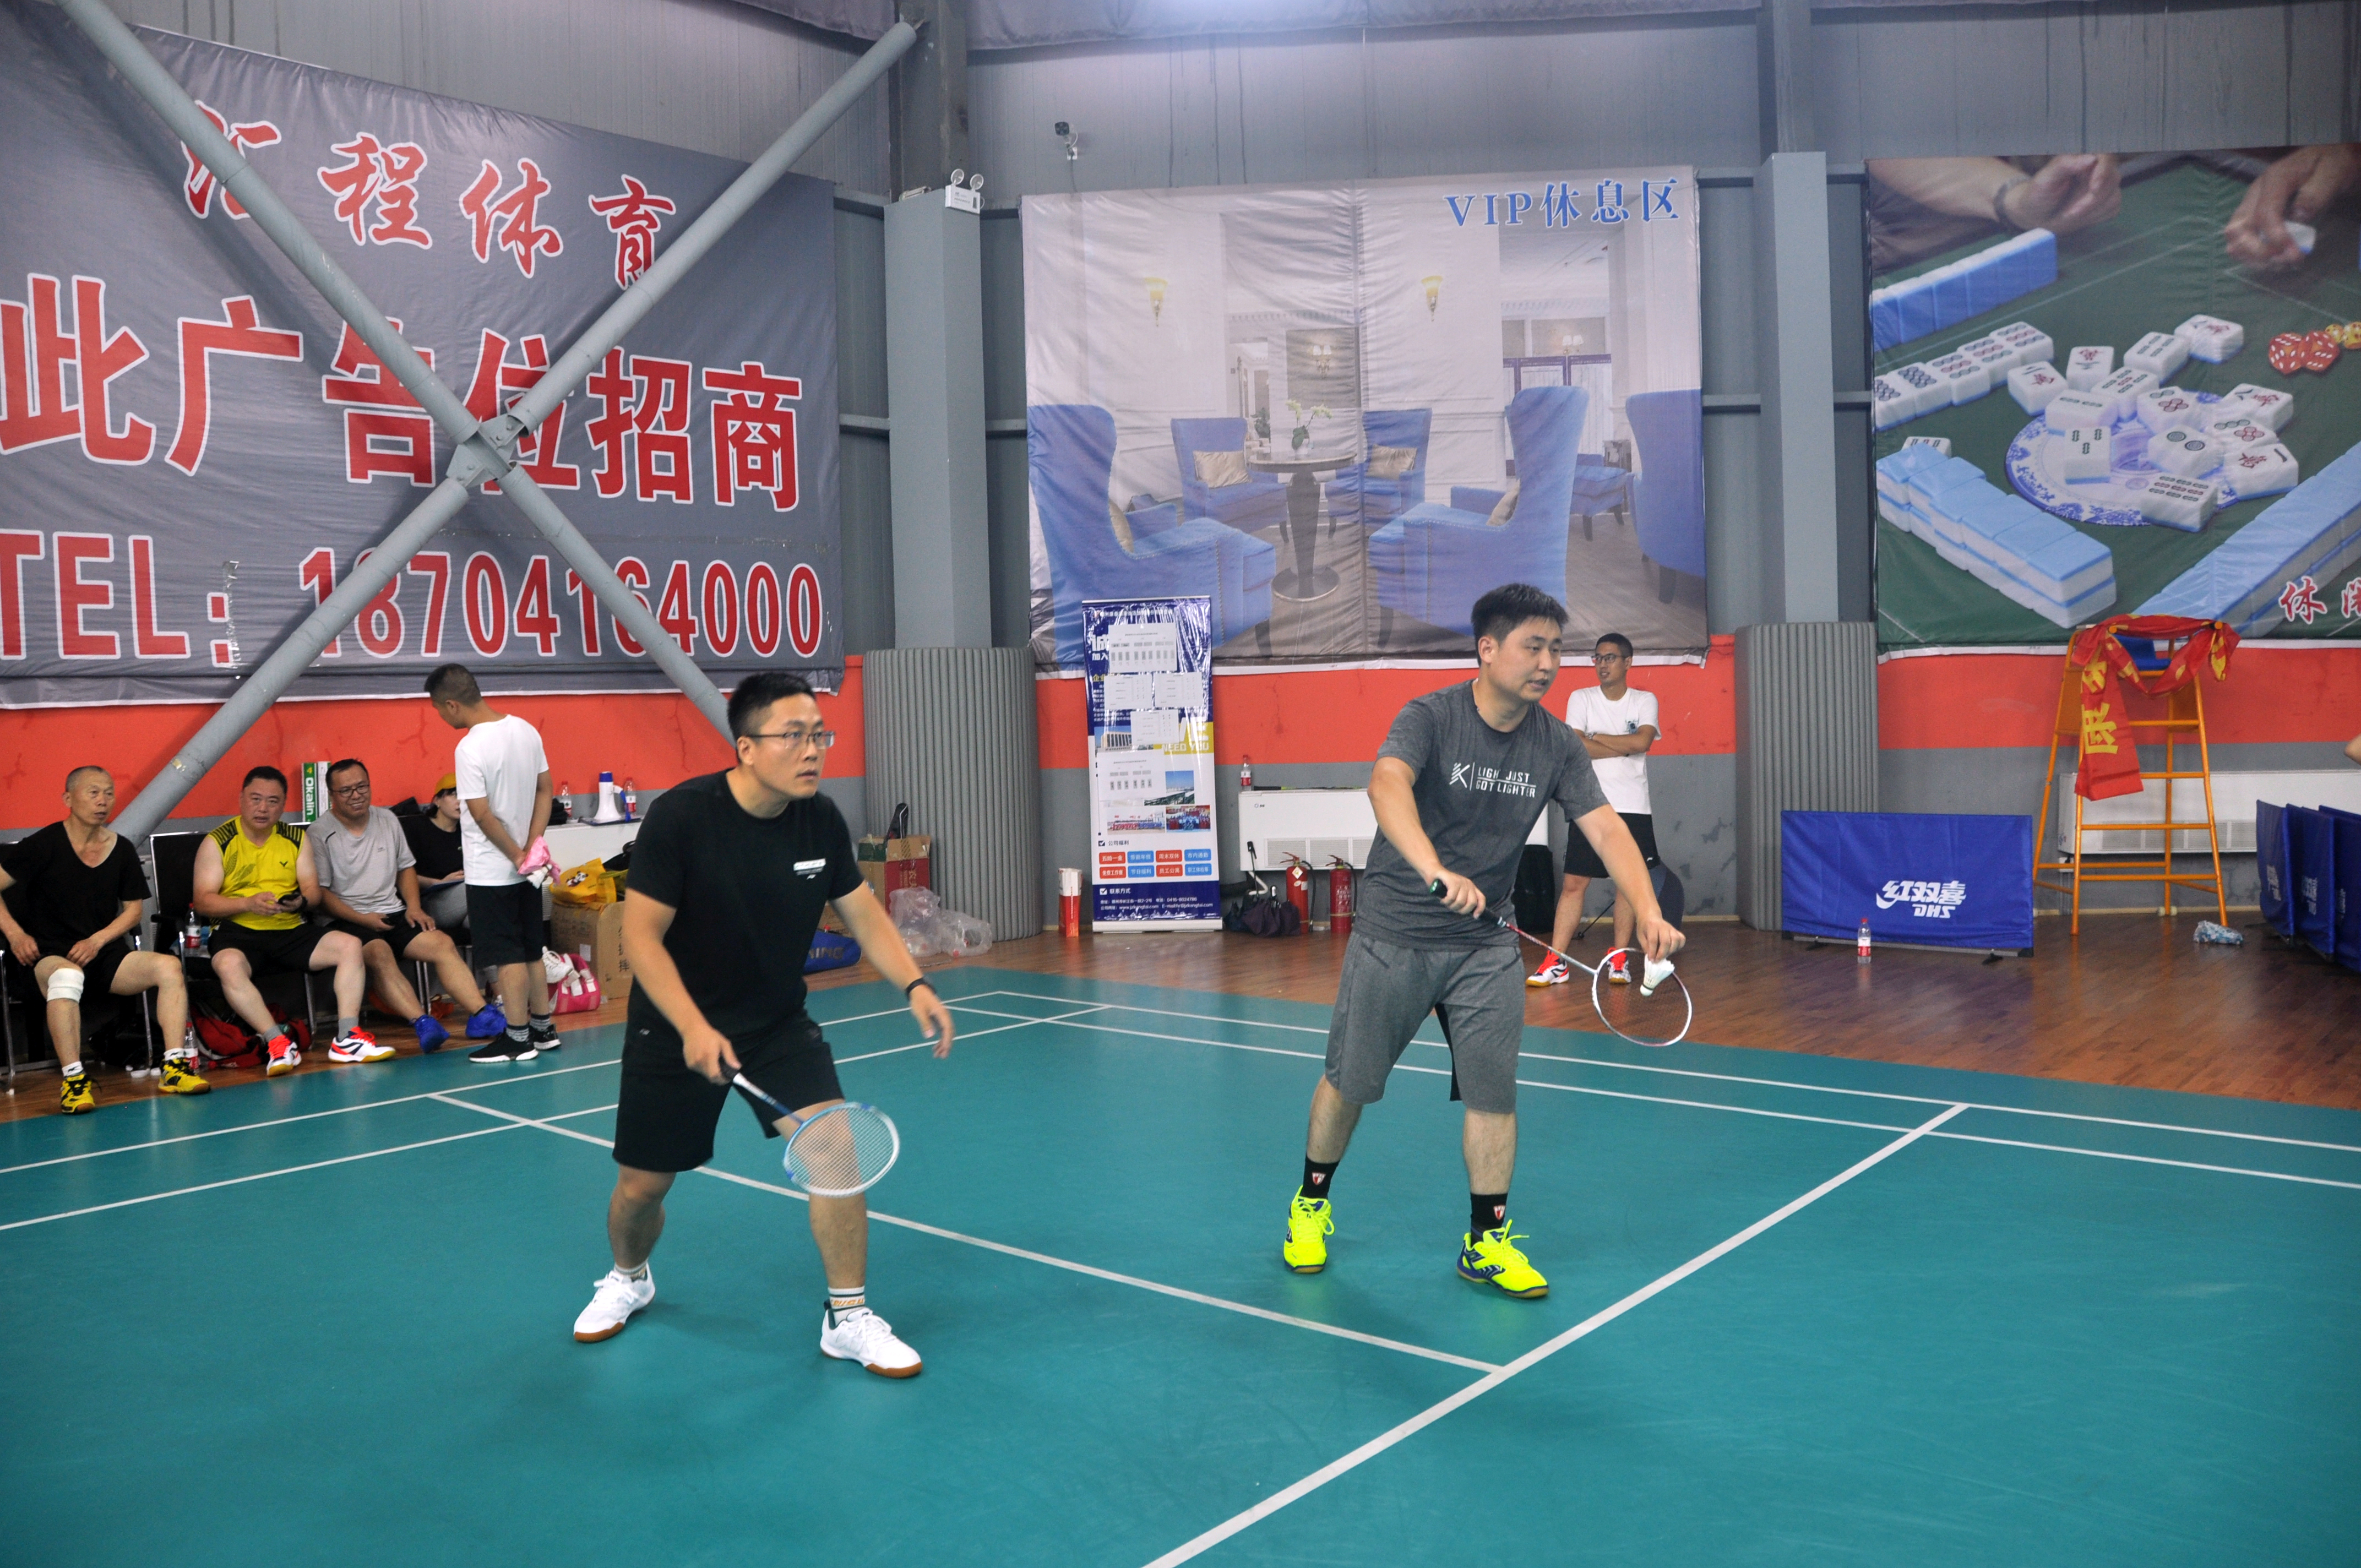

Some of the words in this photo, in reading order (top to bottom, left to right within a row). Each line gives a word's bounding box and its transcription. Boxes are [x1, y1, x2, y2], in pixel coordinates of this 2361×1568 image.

[1443, 179, 1679, 228] VIP休息区
[299, 547, 823, 658] 18704164000
[1162, 743, 1187, 752] NEED
[1478, 766, 1502, 779] LIGH
[1505, 770, 1530, 783] JUST
[1476, 780, 1495, 792] GOT
[1497, 782, 1536, 798] LIGHTER
[1876, 880, 1967, 909] 红双喜
[1912, 903, 1956, 918] DHS
